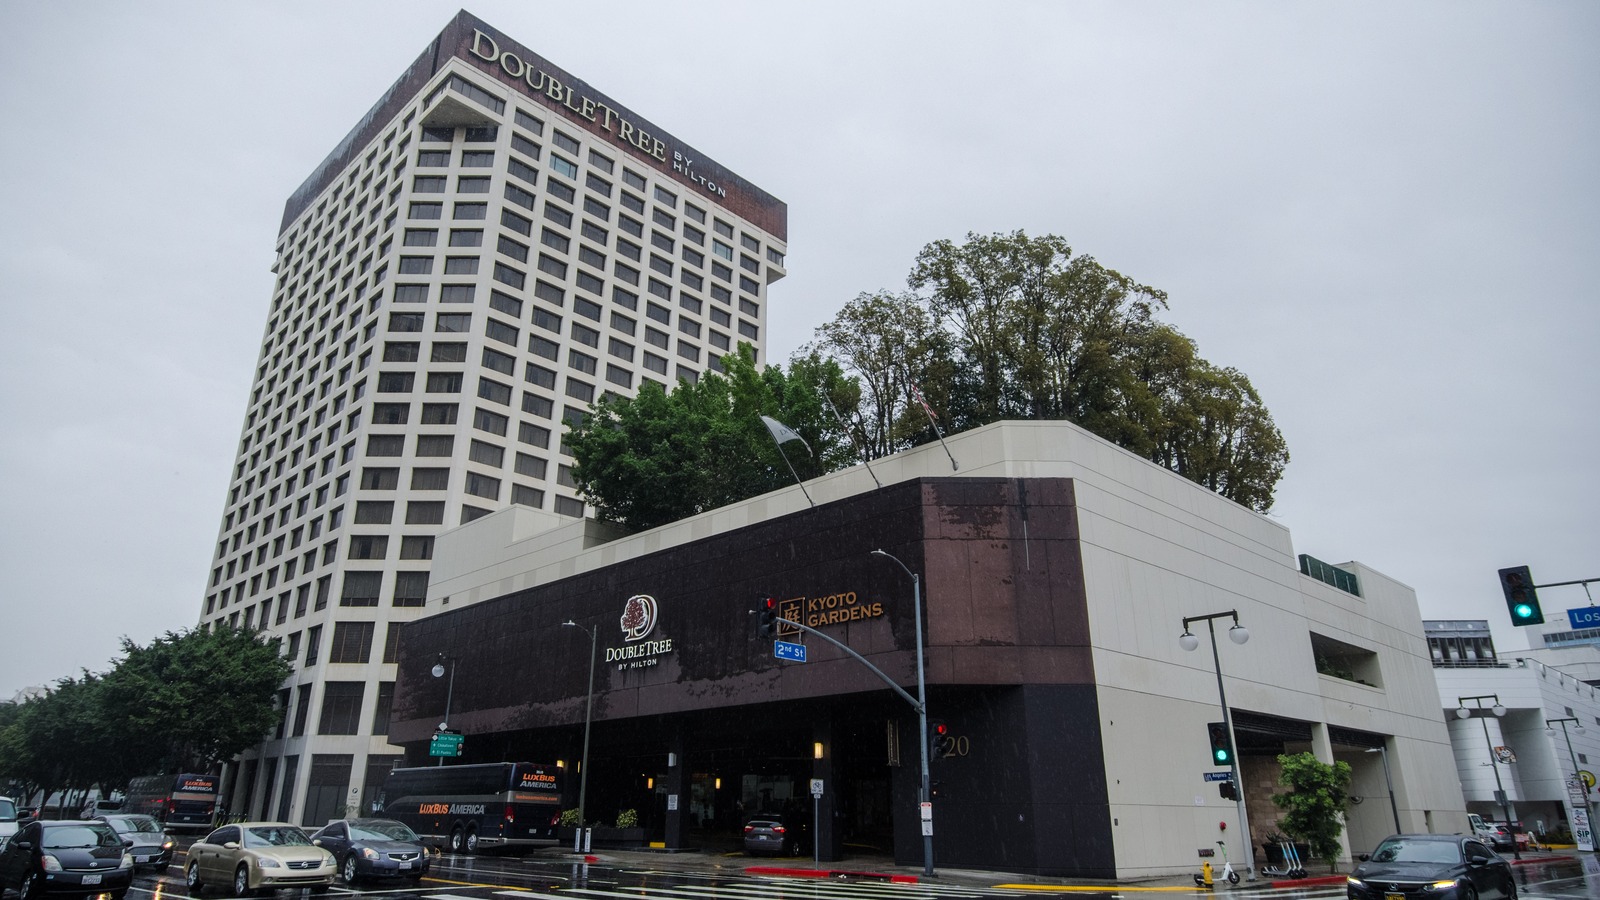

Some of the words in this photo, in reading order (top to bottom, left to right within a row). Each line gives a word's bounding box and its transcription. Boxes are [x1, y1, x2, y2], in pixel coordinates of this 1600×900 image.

[674, 151, 693, 167] BY
[673, 160, 726, 198] HILTON
[808, 592, 857, 612] KYOTO
[808, 603, 884, 627] GARDENS
[777, 644, 792, 656] 2nd
[794, 649, 804, 658] St
[618, 663, 628, 671] BY
[630, 658, 657, 669] HILTON
[520, 780, 557, 789] AMERICA
[448, 803, 485, 814] AMERICA
